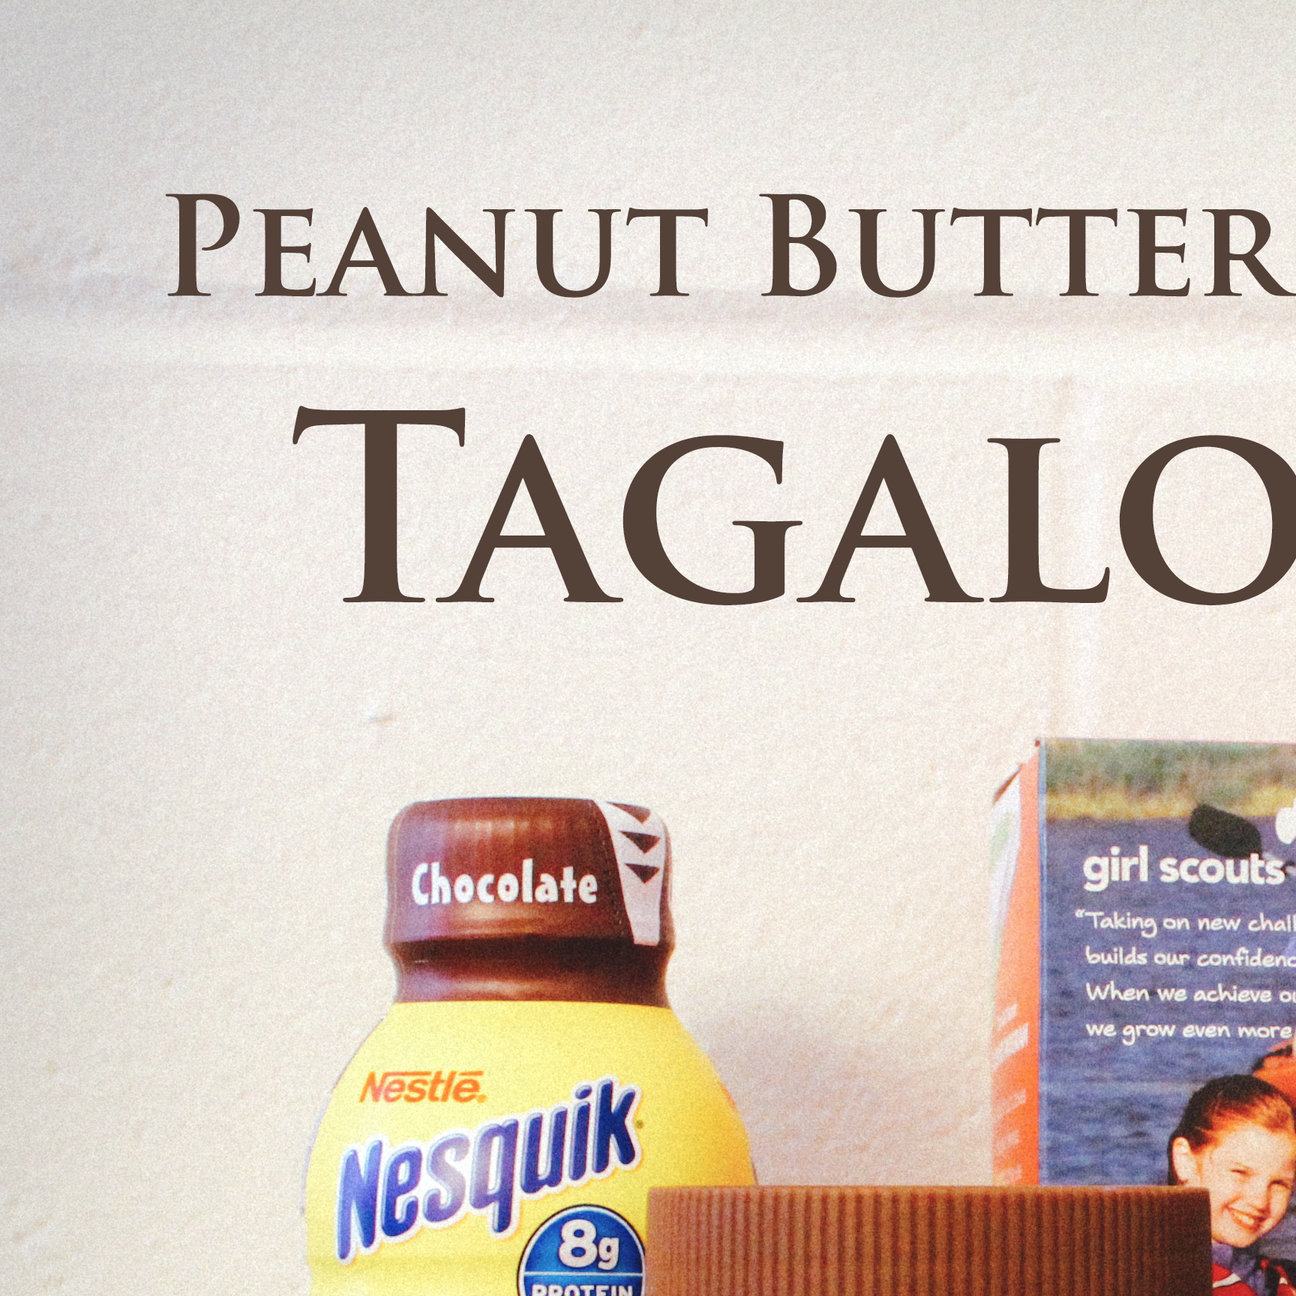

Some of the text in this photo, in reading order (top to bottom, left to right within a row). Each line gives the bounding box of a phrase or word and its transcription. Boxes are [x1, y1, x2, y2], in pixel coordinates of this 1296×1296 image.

[411, 859, 598, 905] Chocolate
[1083, 845, 1285, 891] girl scouts
[1163, 917, 1190, 930] on
[1198, 917, 1241, 930] new
[1086, 946, 1148, 965] builds
[1154, 953, 1190, 965] our
[1086, 981, 1149, 1002] When
[1157, 988, 1187, 1002] we
[1194, 983, 1271, 1003] achieve
[1086, 1023, 1116, 1037] we
[1123, 1025, 1175, 1046] grow
[1183, 1024, 1230, 1039] even
[1238, 1026, 1293, 1040] more
[337, 1077, 641, 1263] Nesquik
[559, 1218, 619, 1270] 8g
